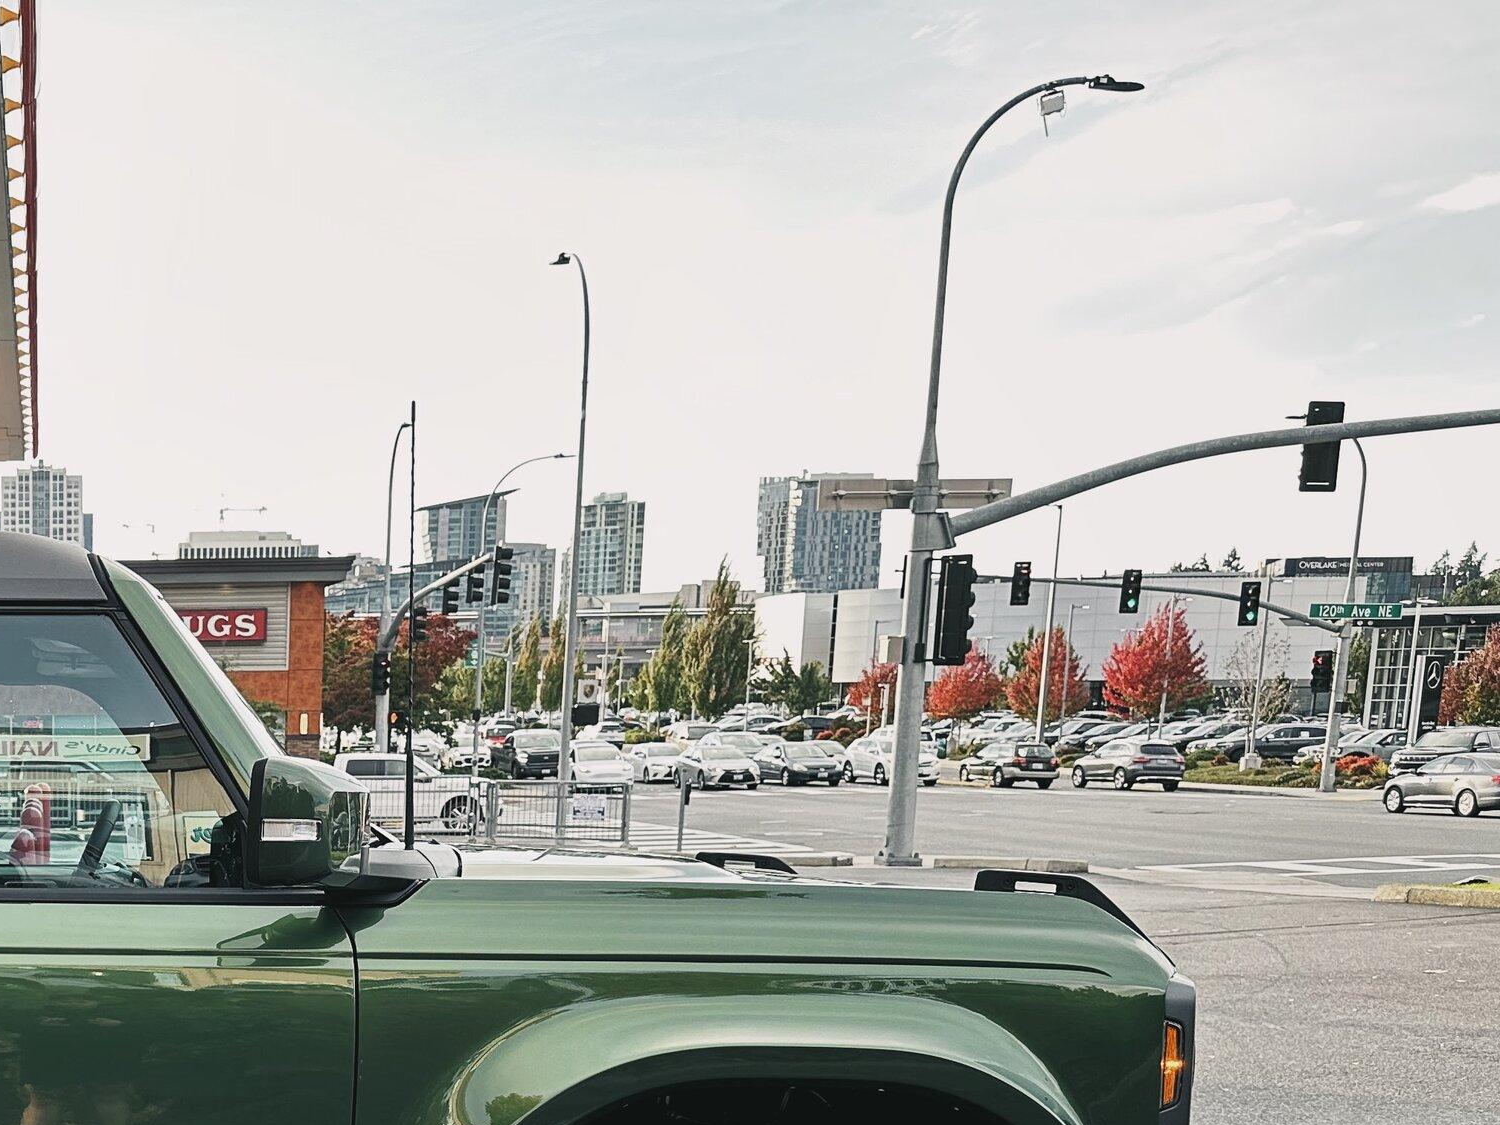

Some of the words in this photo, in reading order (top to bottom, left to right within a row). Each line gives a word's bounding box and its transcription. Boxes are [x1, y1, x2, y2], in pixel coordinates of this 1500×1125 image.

[1298, 560, 1337, 569] OVERLAKE
[1318, 605, 1345, 617] 120th
[1351, 605, 1371, 618] Ave
[1378, 605, 1393, 618] NE
[182, 614, 257, 637] UGS
